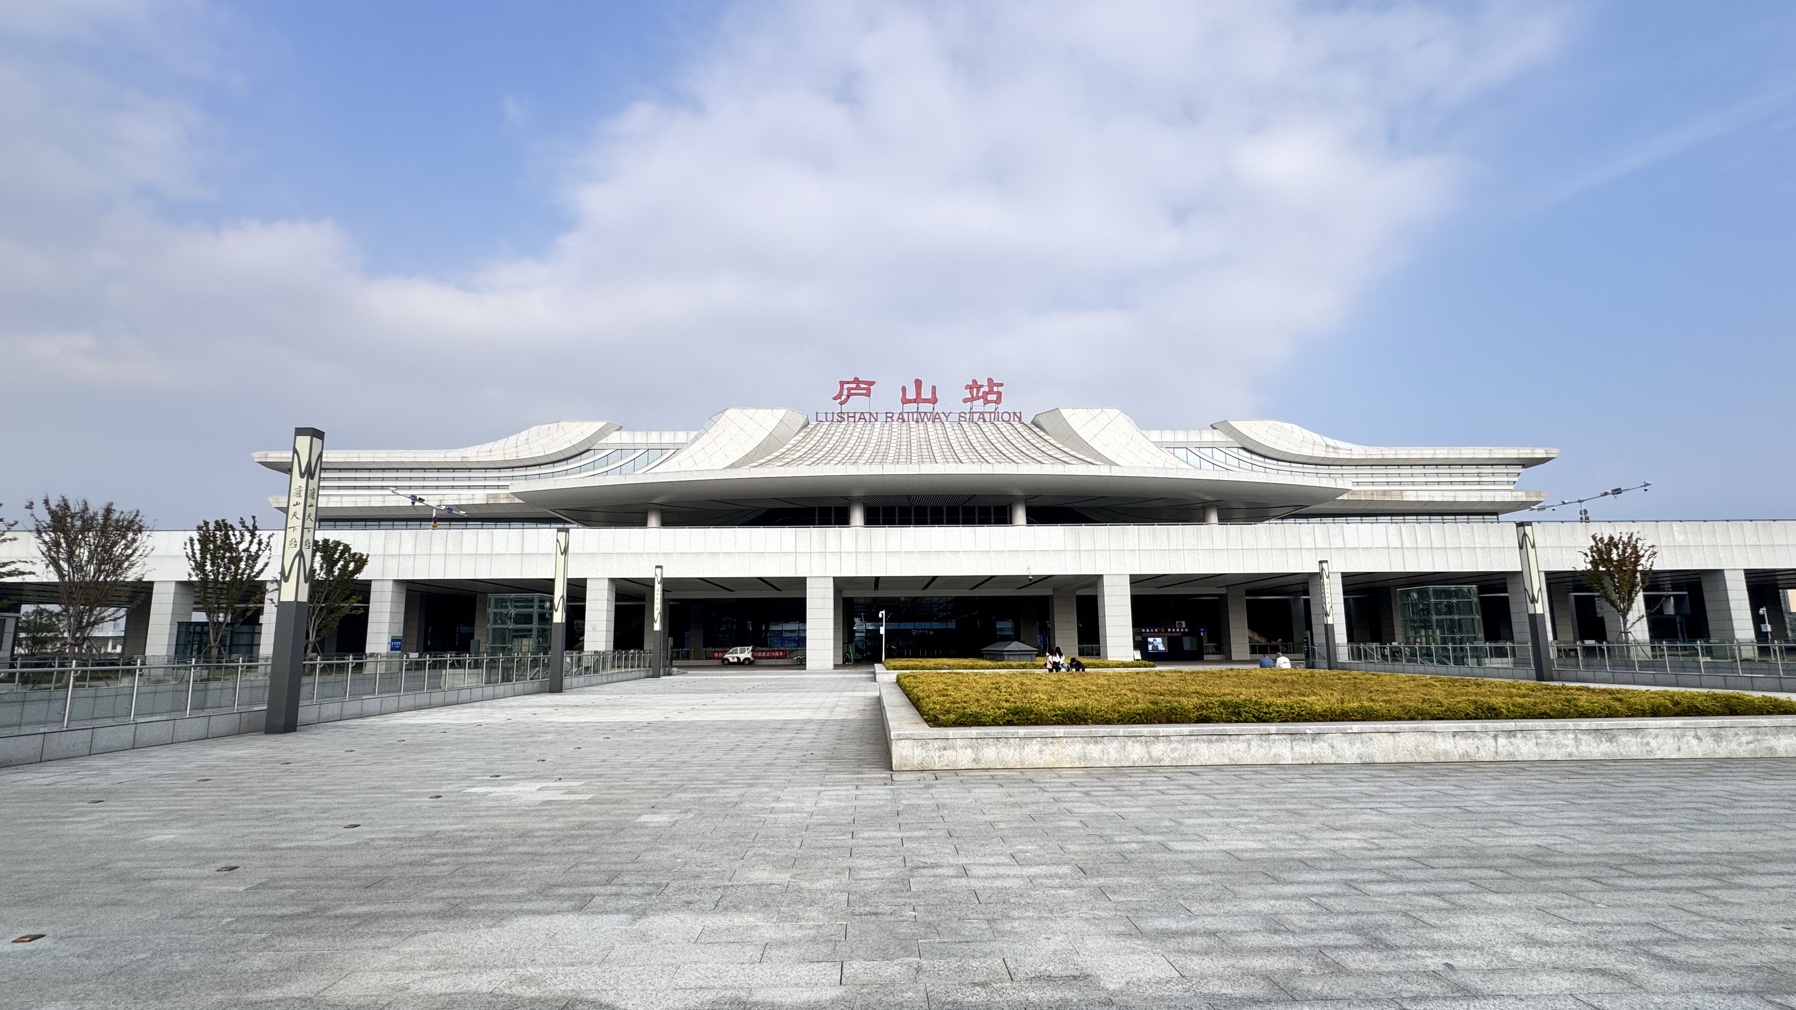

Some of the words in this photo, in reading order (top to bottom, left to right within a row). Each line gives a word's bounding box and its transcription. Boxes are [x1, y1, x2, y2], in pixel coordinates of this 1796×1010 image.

[832, 377, 1004, 405] 庐山站
[815, 411, 879, 423] LUSHAN
[885, 411, 952, 423] RAILWAY
[958, 411, 1022, 423] STATION
